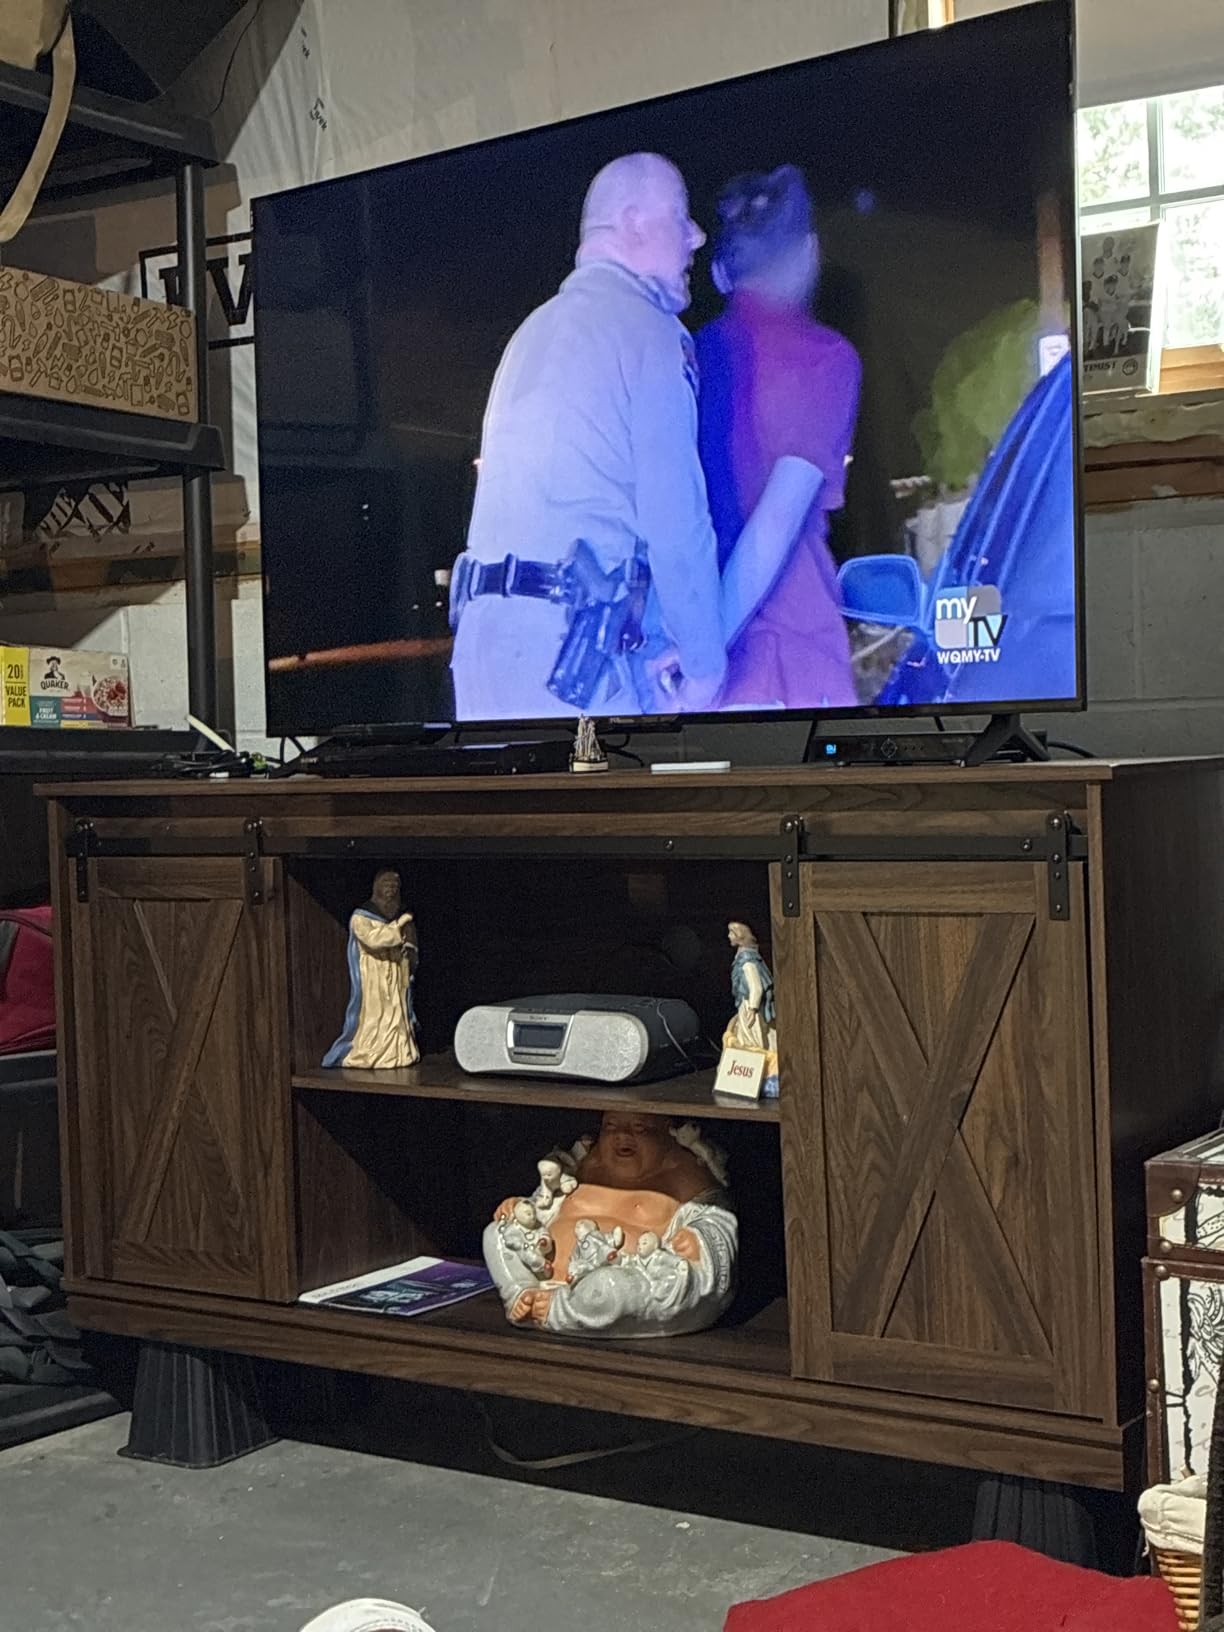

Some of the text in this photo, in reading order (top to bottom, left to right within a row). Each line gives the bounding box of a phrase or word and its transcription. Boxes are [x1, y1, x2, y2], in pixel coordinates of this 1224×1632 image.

[936, 596, 977, 625] my
[969, 614, 1008, 647] TV
[7, 664, 20, 679] 20
[5, 685, 27, 697] VALUE
[40, 680, 69, 690] QUAKER
[8, 698, 26, 708] PACK
[727, 1060, 754, 1078] Jesus
